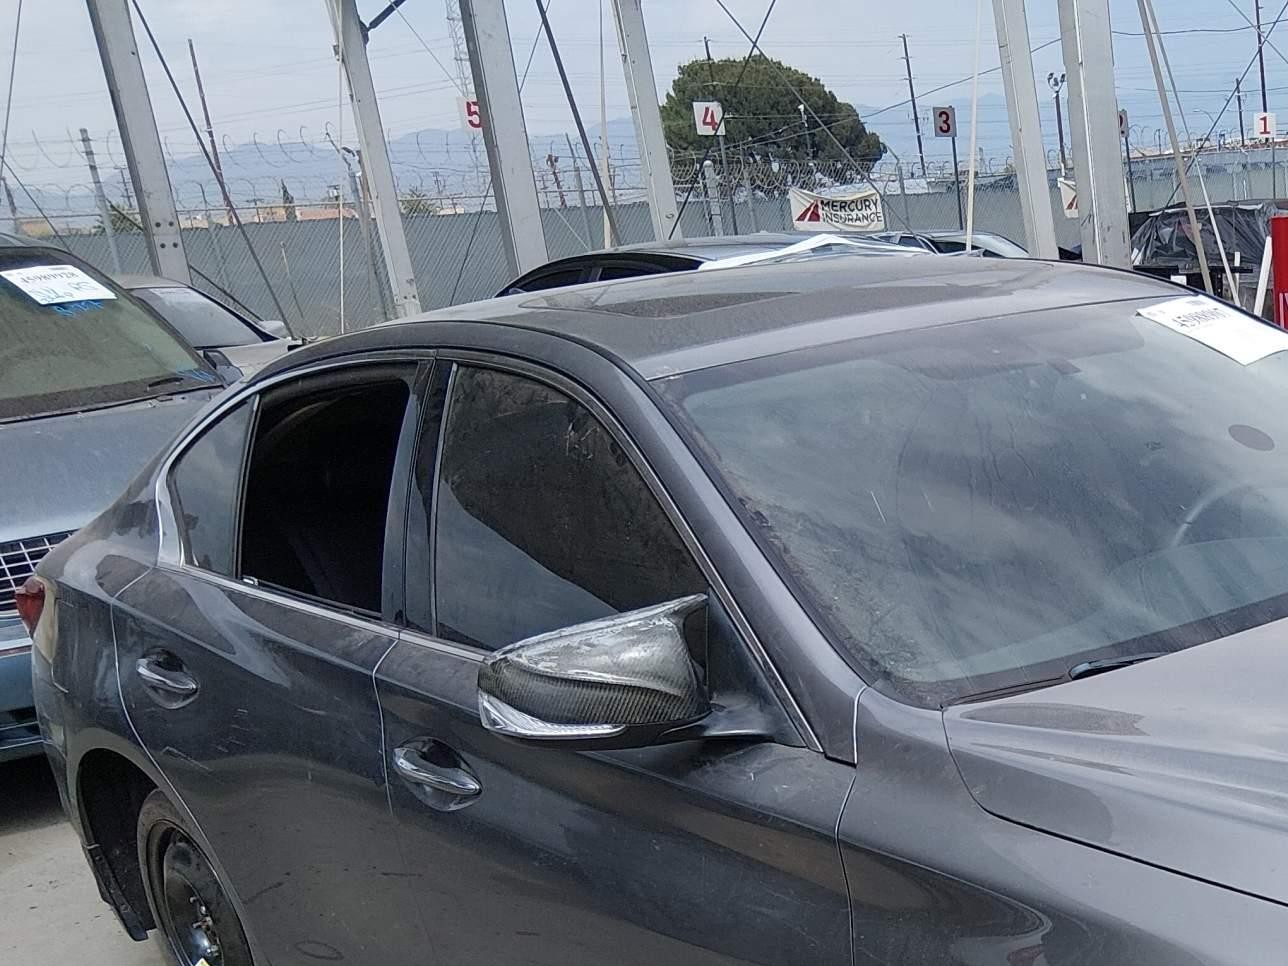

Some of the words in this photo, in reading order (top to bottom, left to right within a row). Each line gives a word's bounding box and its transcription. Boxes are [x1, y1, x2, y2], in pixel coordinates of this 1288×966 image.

[466, 101, 481, 128] 5
[702, 106, 718, 131] 4
[938, 110, 951, 134] 3
[1259, 115, 1271, 135] 1
[820, 199, 879, 213] MERCURY
[822, 211, 883, 224] INSURANCE
